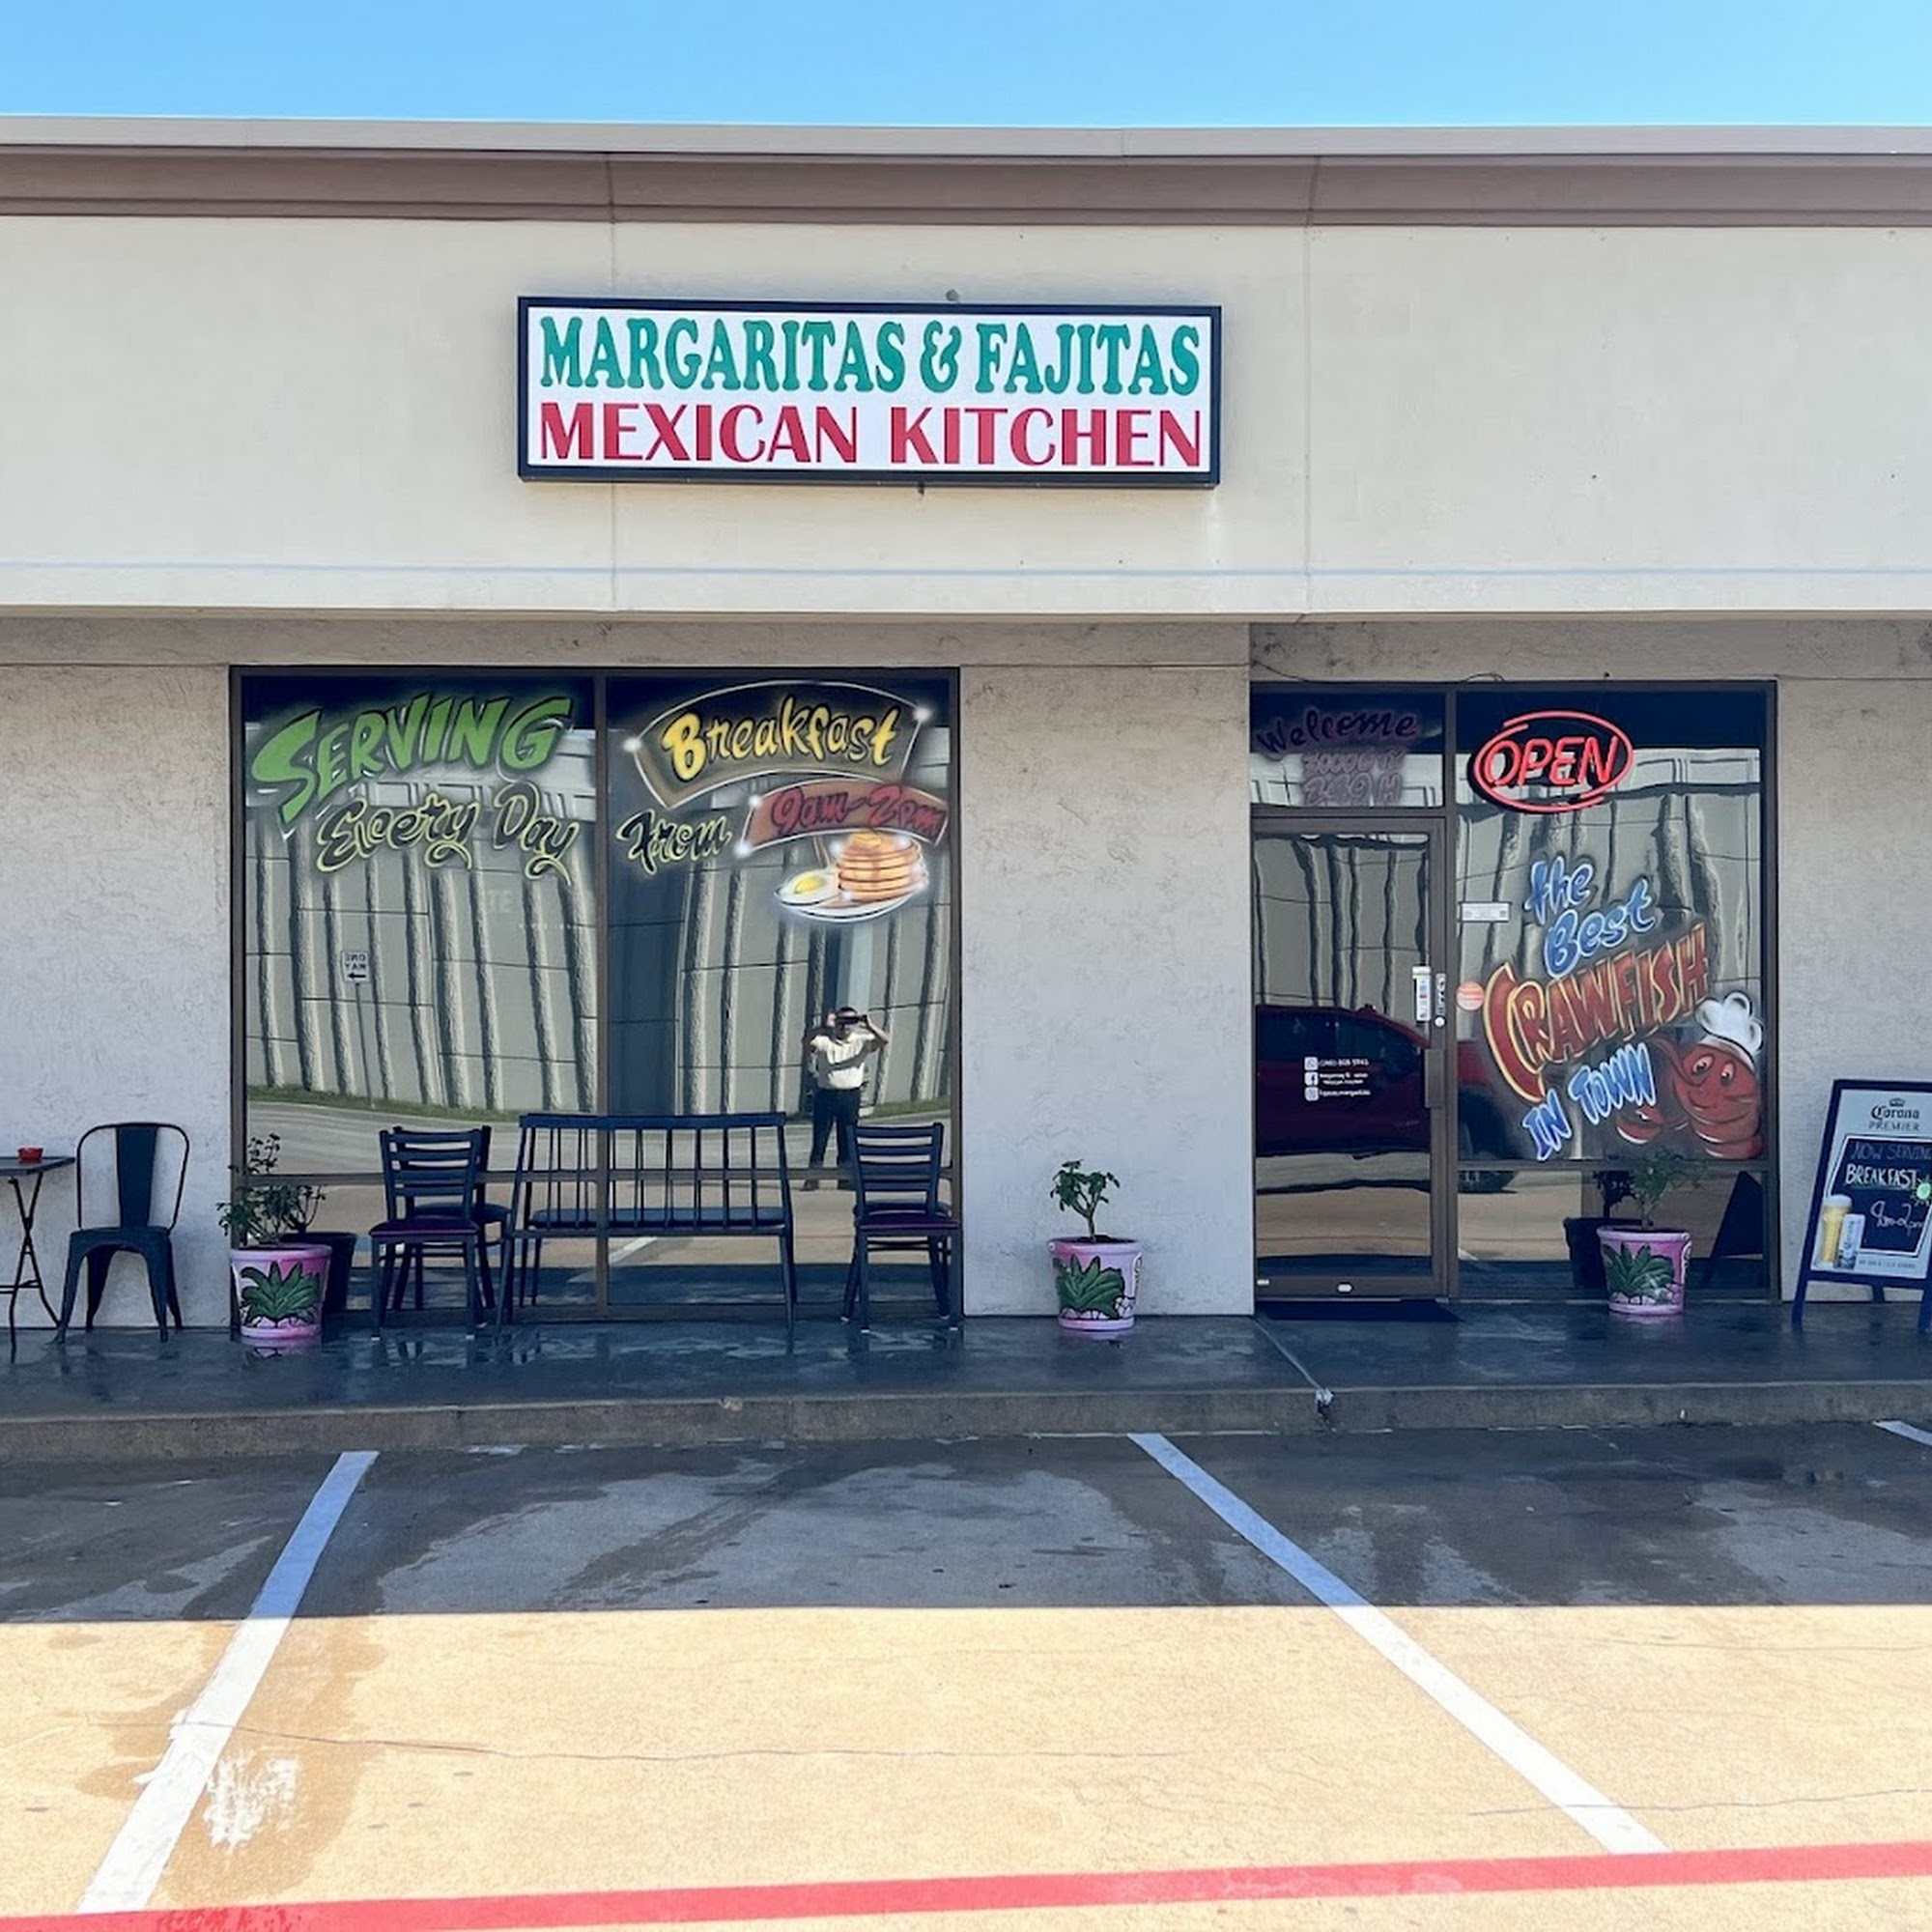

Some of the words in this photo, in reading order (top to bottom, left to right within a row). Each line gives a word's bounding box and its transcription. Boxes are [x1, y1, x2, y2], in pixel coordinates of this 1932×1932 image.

[539, 316, 905, 394] MARGARITAS
[920, 321, 961, 395] &
[975, 322, 1200, 397] FAJITAS
[540, 402, 859, 465] MEXICAN
[890, 406, 1202, 468] KITCHEN
[251, 692, 574, 825] SERVING
[661, 694, 903, 782] Breakfast
[1484, 734, 1621, 790] OPEN
[315, 793, 480, 873] Every
[493, 781, 582, 887] Day
[615, 809, 733, 877] From
[1523, 854, 1596, 926] the
[1545, 877, 1657, 980] Best
[1483, 922, 1710, 1103] CRAWFISH
[1523, 1088, 1573, 1161] IN
[1569, 1041, 1657, 1124] TOWN
[1869, 1121, 1920, 1131] PREMIER
[1871, 1104, 1919, 1122] Corona
[1846, 1163, 1918, 1189] BREAKFAST
[1887, 1144, 1932, 1160] SERVIN
